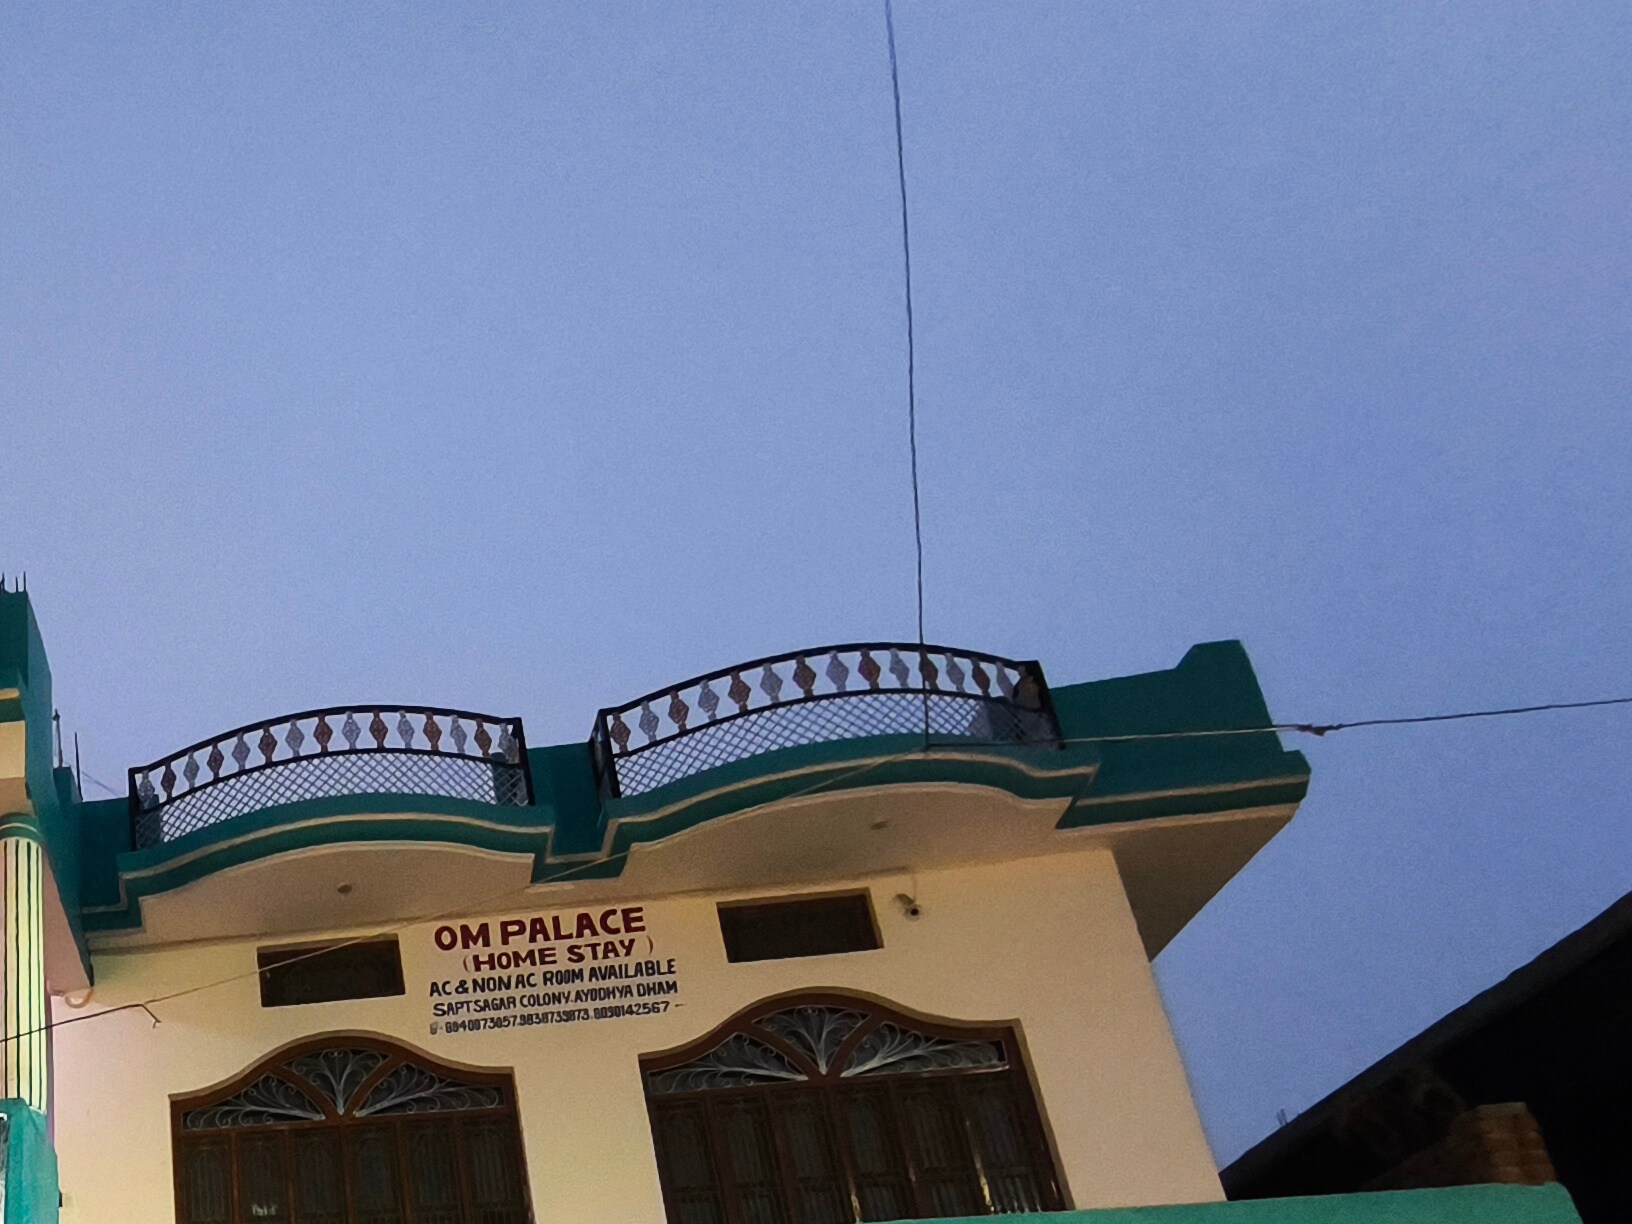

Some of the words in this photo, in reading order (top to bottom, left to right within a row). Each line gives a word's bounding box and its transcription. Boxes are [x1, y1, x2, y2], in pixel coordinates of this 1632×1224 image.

[434, 922, 490, 951] OM
[499, 906, 646, 946] PALACE
[429, 980, 452, 997] AC
[455, 979, 469, 994] &
[472, 974, 512, 993] NON
[515, 972, 536, 990] AC
[543, 968, 584, 987] ROOM
[588, 959, 677, 982] AVAILABLE
[637, 980, 678, 998] DHAM
